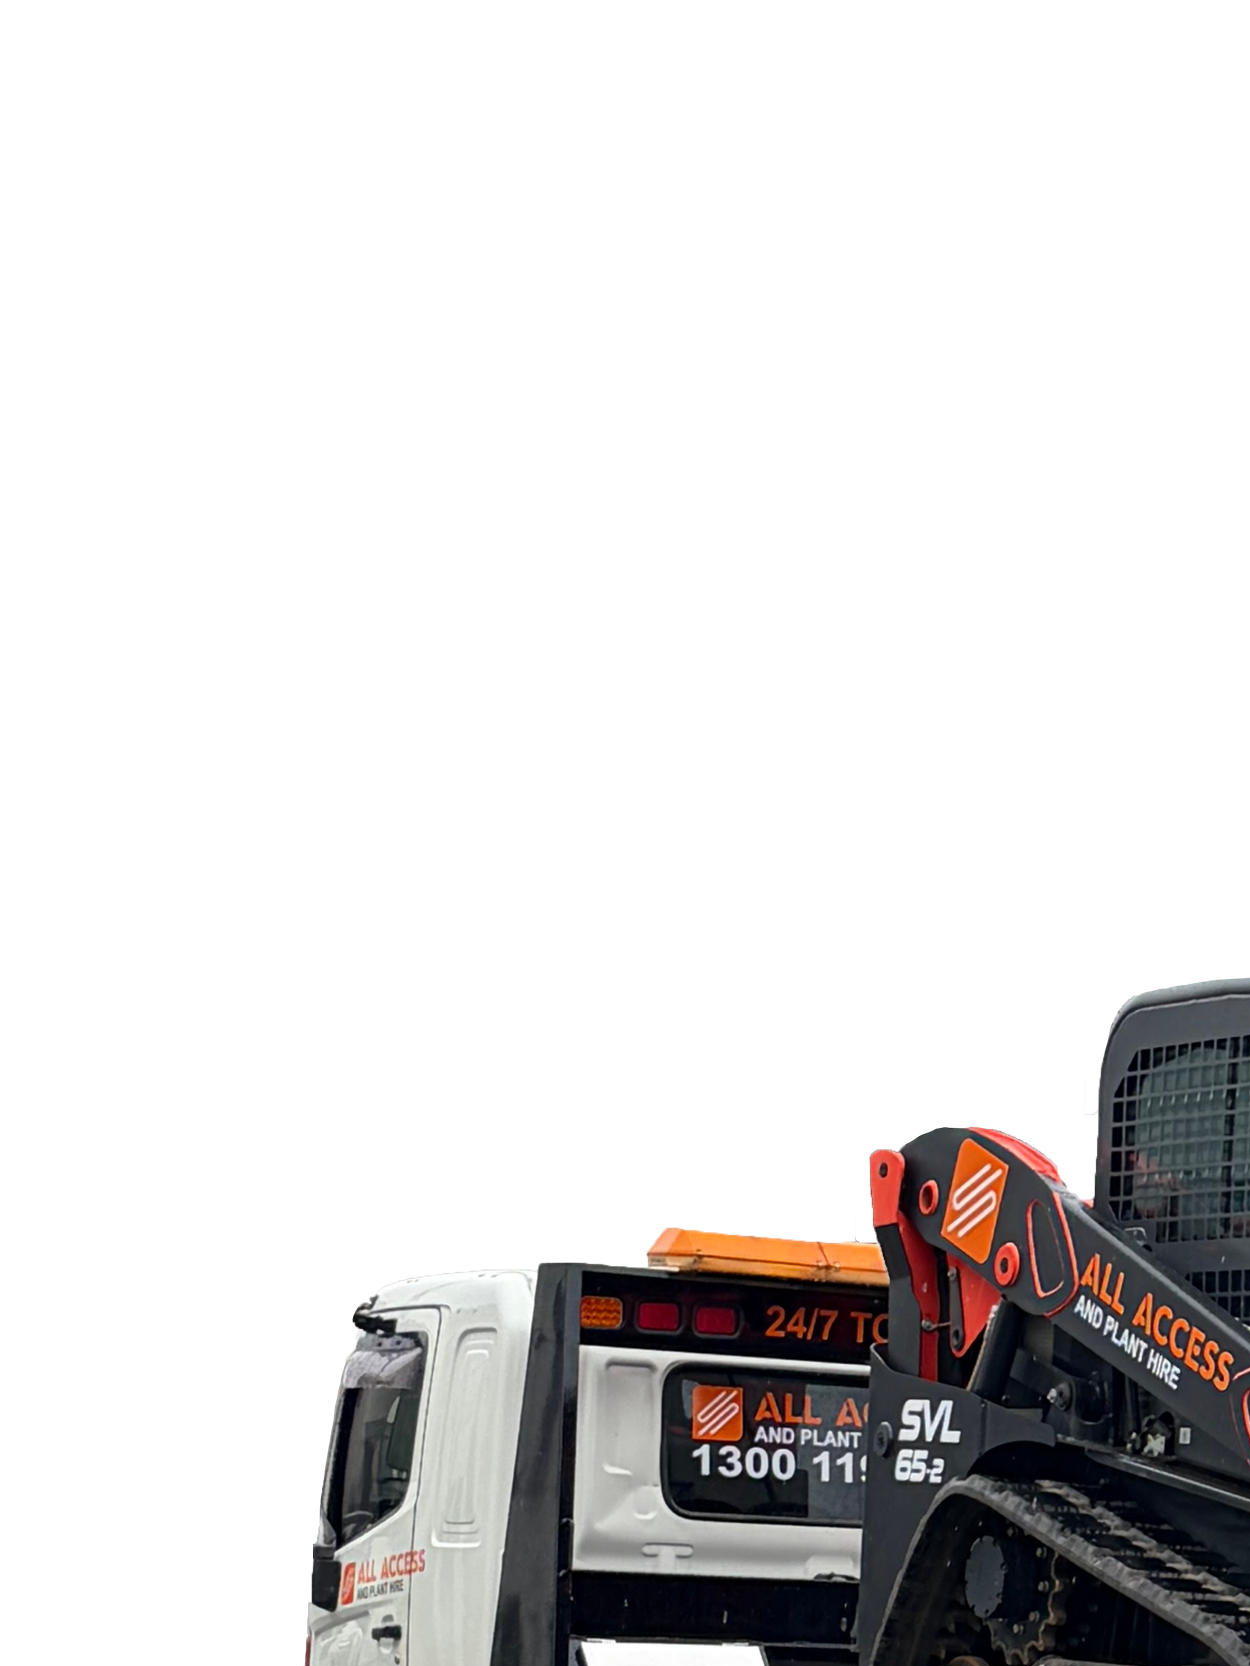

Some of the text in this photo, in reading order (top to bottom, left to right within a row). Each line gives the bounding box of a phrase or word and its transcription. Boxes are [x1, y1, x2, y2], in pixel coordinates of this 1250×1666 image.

[765, 1305, 839, 1341] 24/7
[1080, 1253, 1235, 1392] ALL ACCESS
[1073, 1294, 1181, 1390] AND PLANT HIRE
[755, 1392, 868, 1428] ALL A
[898, 1399, 961, 1444] SVL
[754, 1426, 862, 1448] AND PLANT
[692, 1443, 796, 1481] 1300
[895, 1449, 945, 1484] 65-2
[358, 1549, 426, 1584] ALL ACCESS
[369, 1581, 388, 1598] PLANT
[389, 1579, 404, 1594] HIRE
